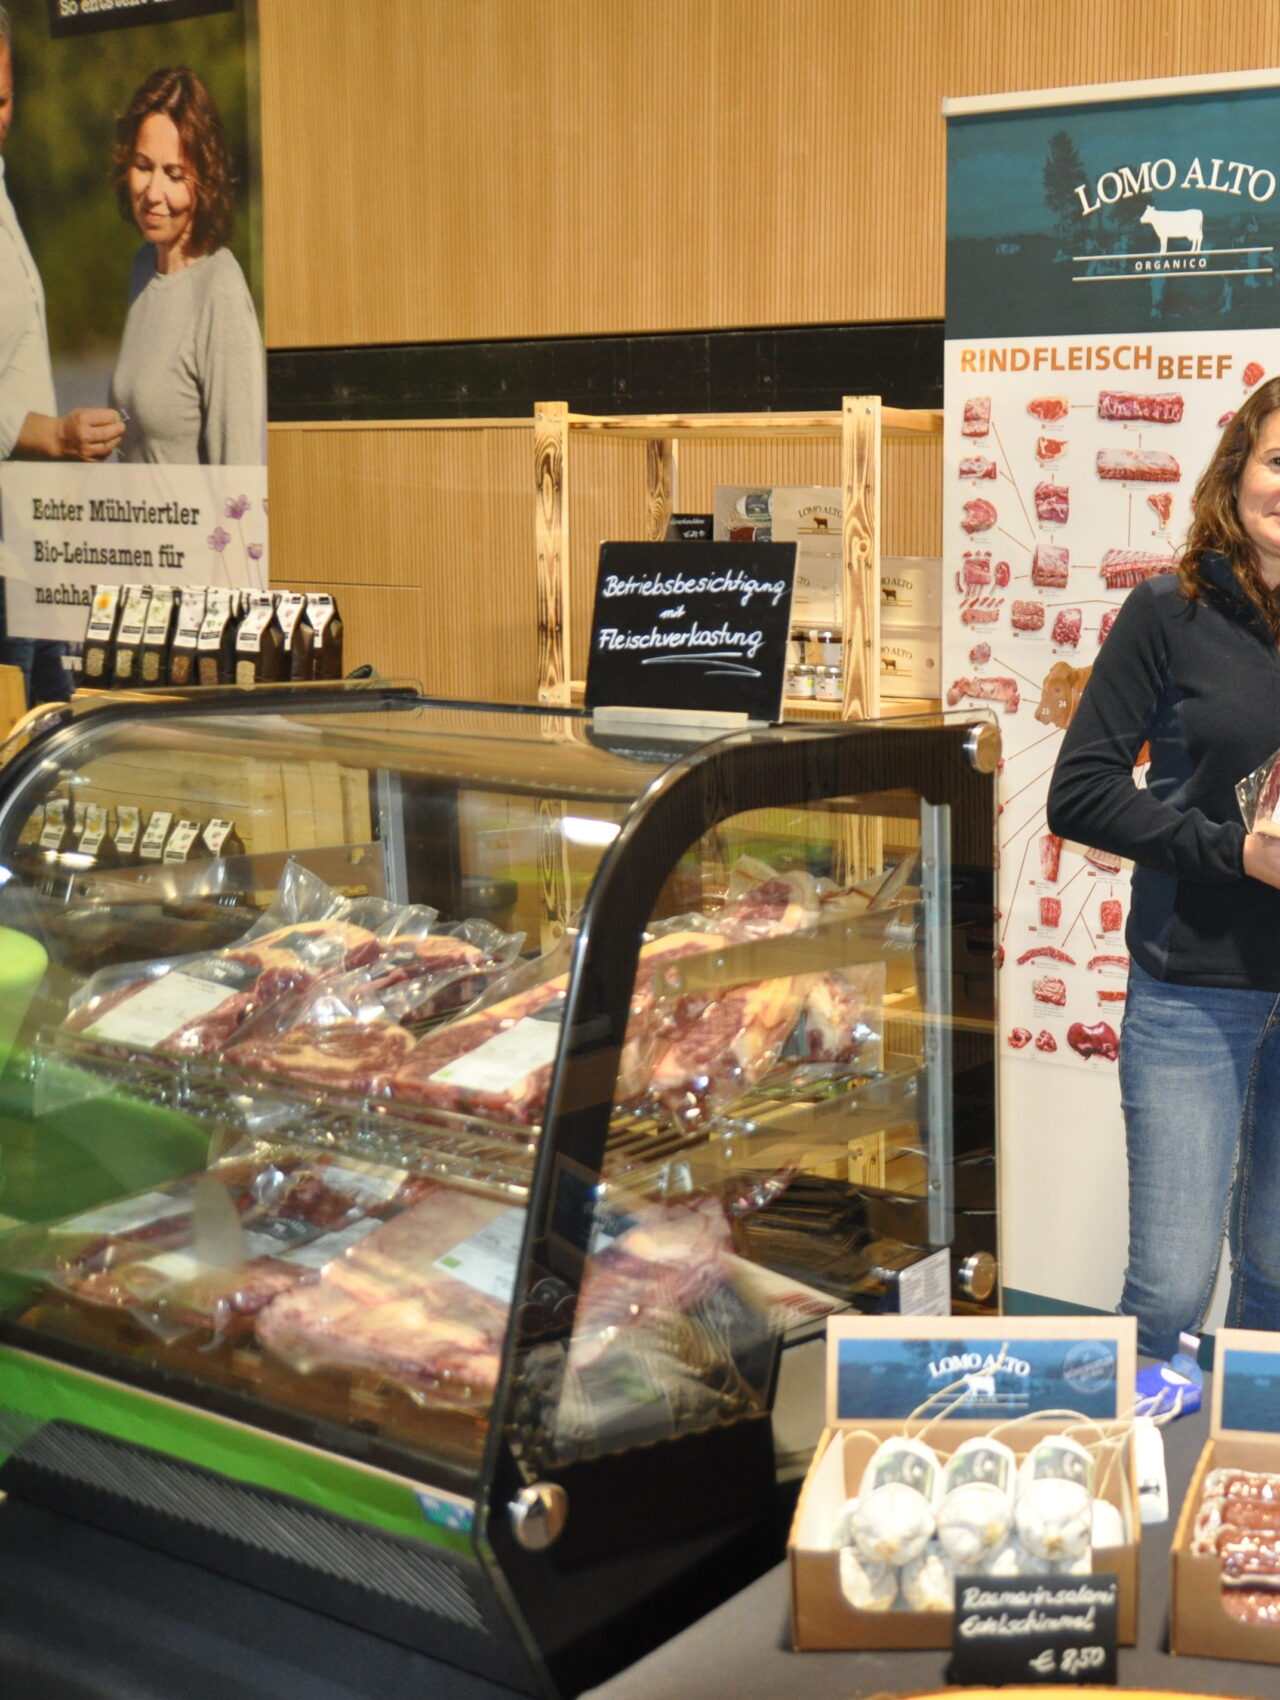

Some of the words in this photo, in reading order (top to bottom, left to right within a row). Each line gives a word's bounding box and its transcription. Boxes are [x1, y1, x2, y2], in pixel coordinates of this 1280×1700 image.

[1073, 157, 1177, 216] LOMO
[1180, 157, 1276, 203] ALTO
[1134, 258, 1208, 271] ORGANICO
[961, 345, 1152, 373] RINDFLEISCH
[1157, 354, 1233, 380] BEEF
[33, 499, 84, 522] Echter
[89, 499, 199, 525] Mühlviertler
[798, 505, 821, 518] LOMO
[34, 541, 153, 567] Bio-Leinsamen
[159, 545, 184, 568] für
[602, 569, 787, 607] Betriebsbesichtigung
[891, 577, 913, 590] ALTO
[659, 604, 686, 619] mit
[599, 621, 766, 658] Fleischverkostung
[890, 647, 913, 660] ALTO
[928, 1353, 982, 1378] LOMO
[1029, 1649, 1056, 1673] €
